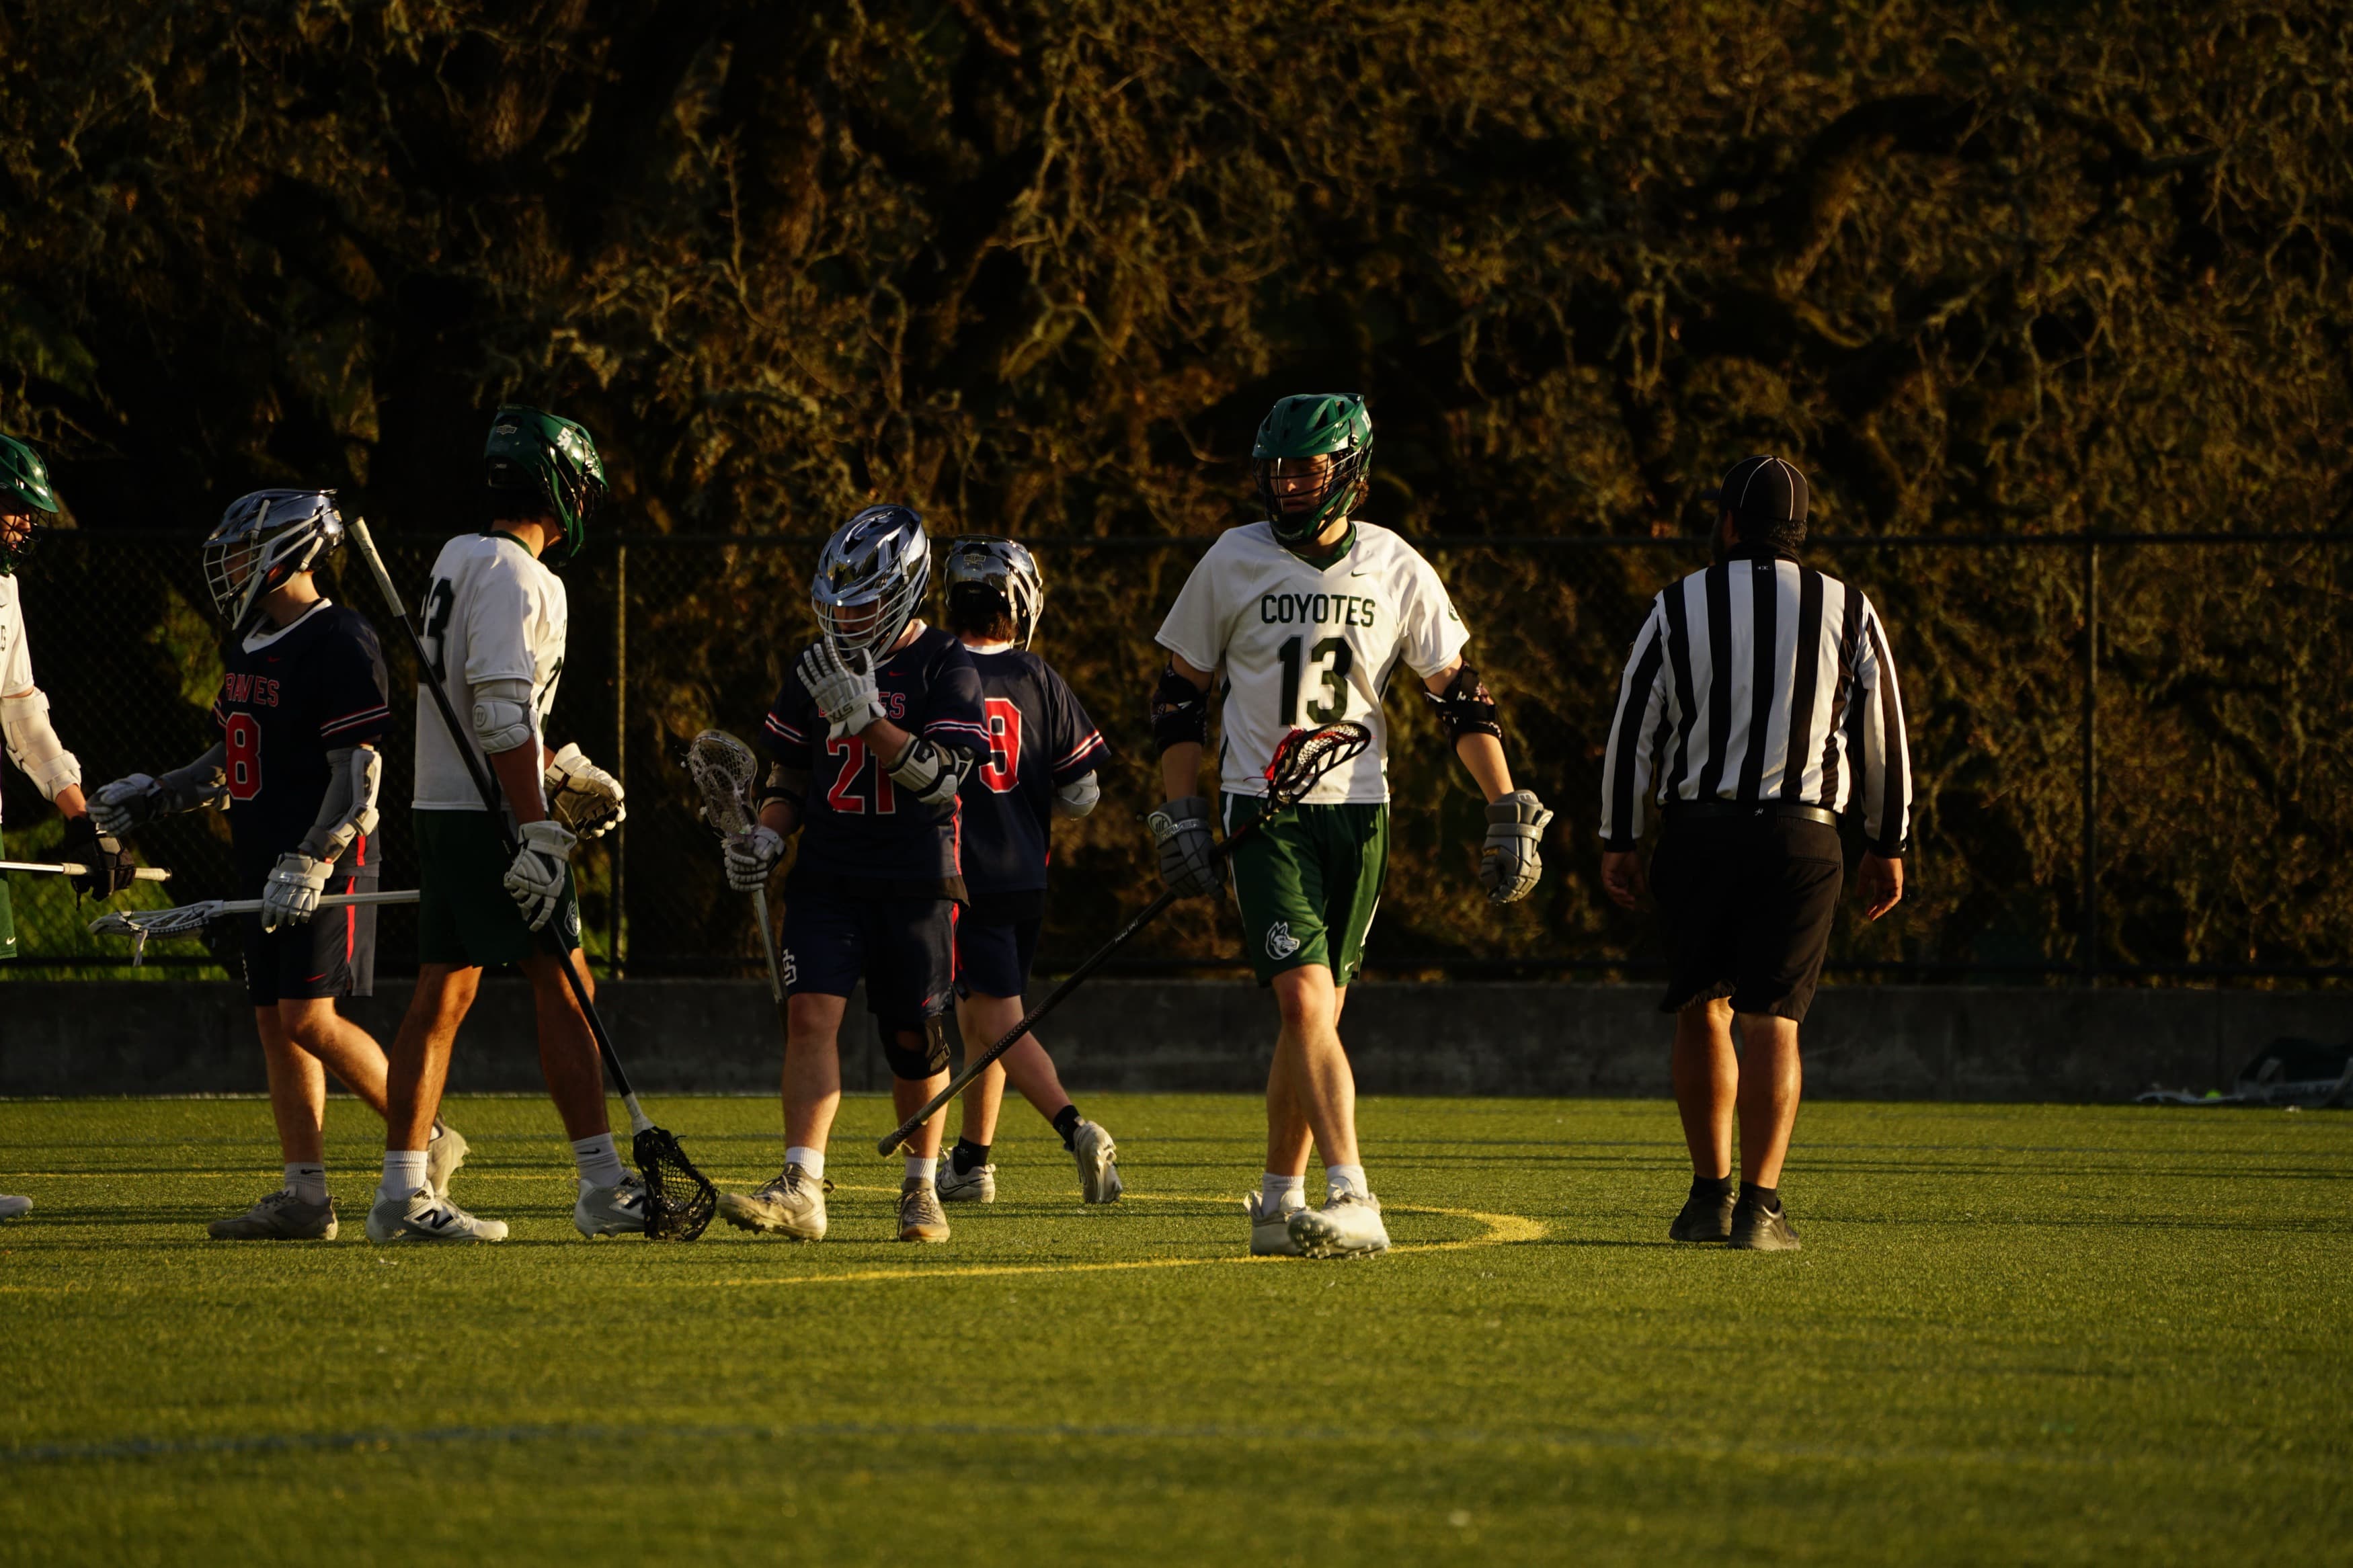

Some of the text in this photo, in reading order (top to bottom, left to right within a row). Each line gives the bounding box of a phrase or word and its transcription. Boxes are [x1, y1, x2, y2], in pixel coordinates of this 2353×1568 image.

[1261, 593, 1376, 628] COYOTES
[226, 673, 280, 708] RAVES
[1277, 634, 1353, 727] 13
[226, 711, 262, 801] 8
[826, 734, 896, 815] 21
[979, 698, 1021, 794] 9
